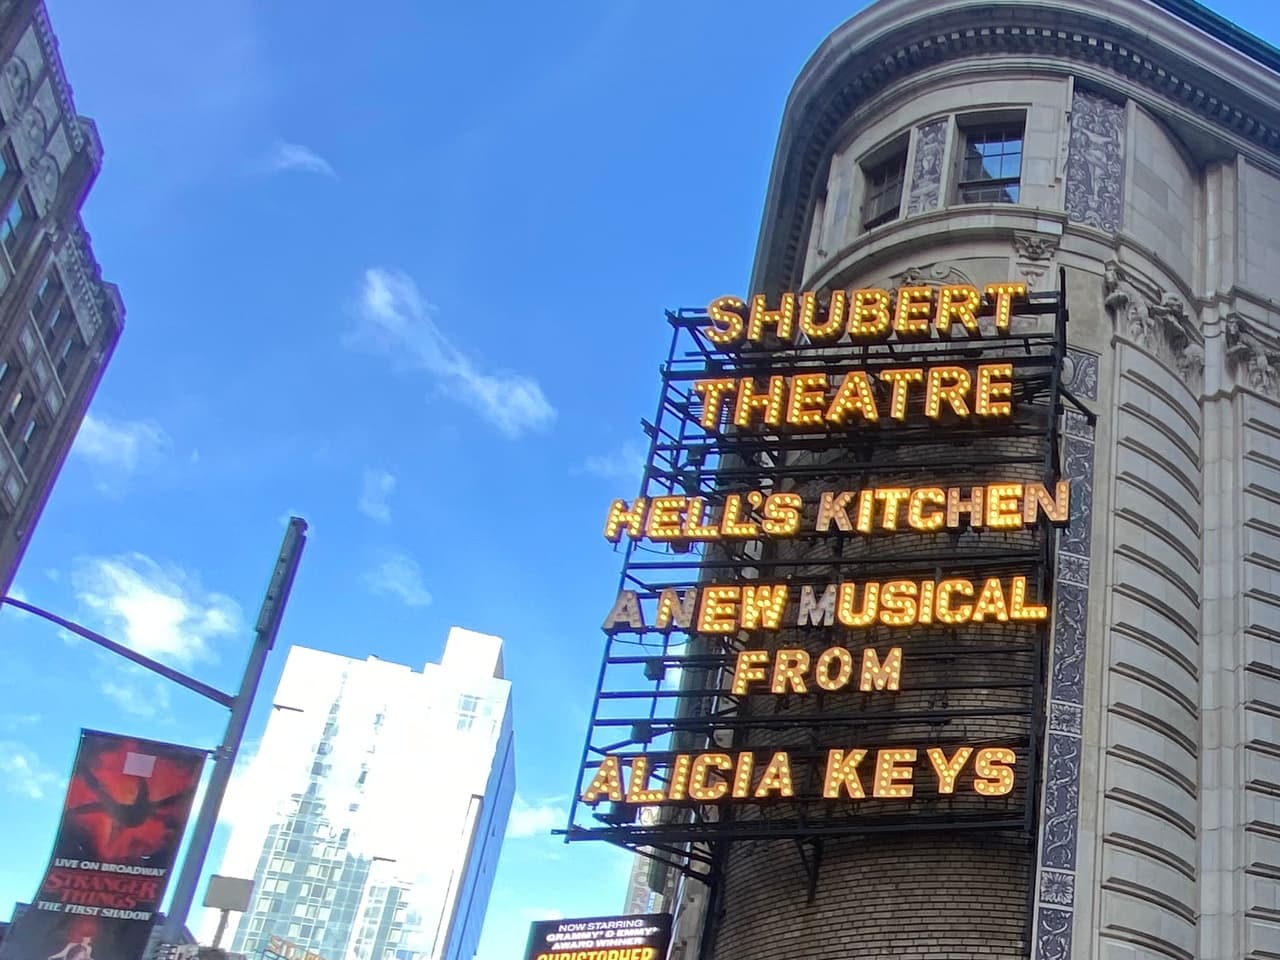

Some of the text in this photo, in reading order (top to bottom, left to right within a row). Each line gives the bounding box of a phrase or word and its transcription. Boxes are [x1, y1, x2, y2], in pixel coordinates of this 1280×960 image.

[703, 282, 1027, 345] SHUBERT
[693, 364, 1014, 430] THEATRE
[604, 480, 1070, 544] HELL'S KITCHEN
[602, 577, 1047, 634] A NEW MUSICAL
[731, 646, 903, 696] FROM
[581, 747, 1016, 804] ALICIA KEYS
[45, 871, 158, 899] STRANGER
[55, 858, 167, 877] LIVE ON BROADWAY
[37, 901, 152, 921] THE FIRST SHADOW
[61, 888, 136, 909] THINGS
[552, 937, 643, 950] AWARD WINNER
[558, 919, 643, 932] NOW STARRING
